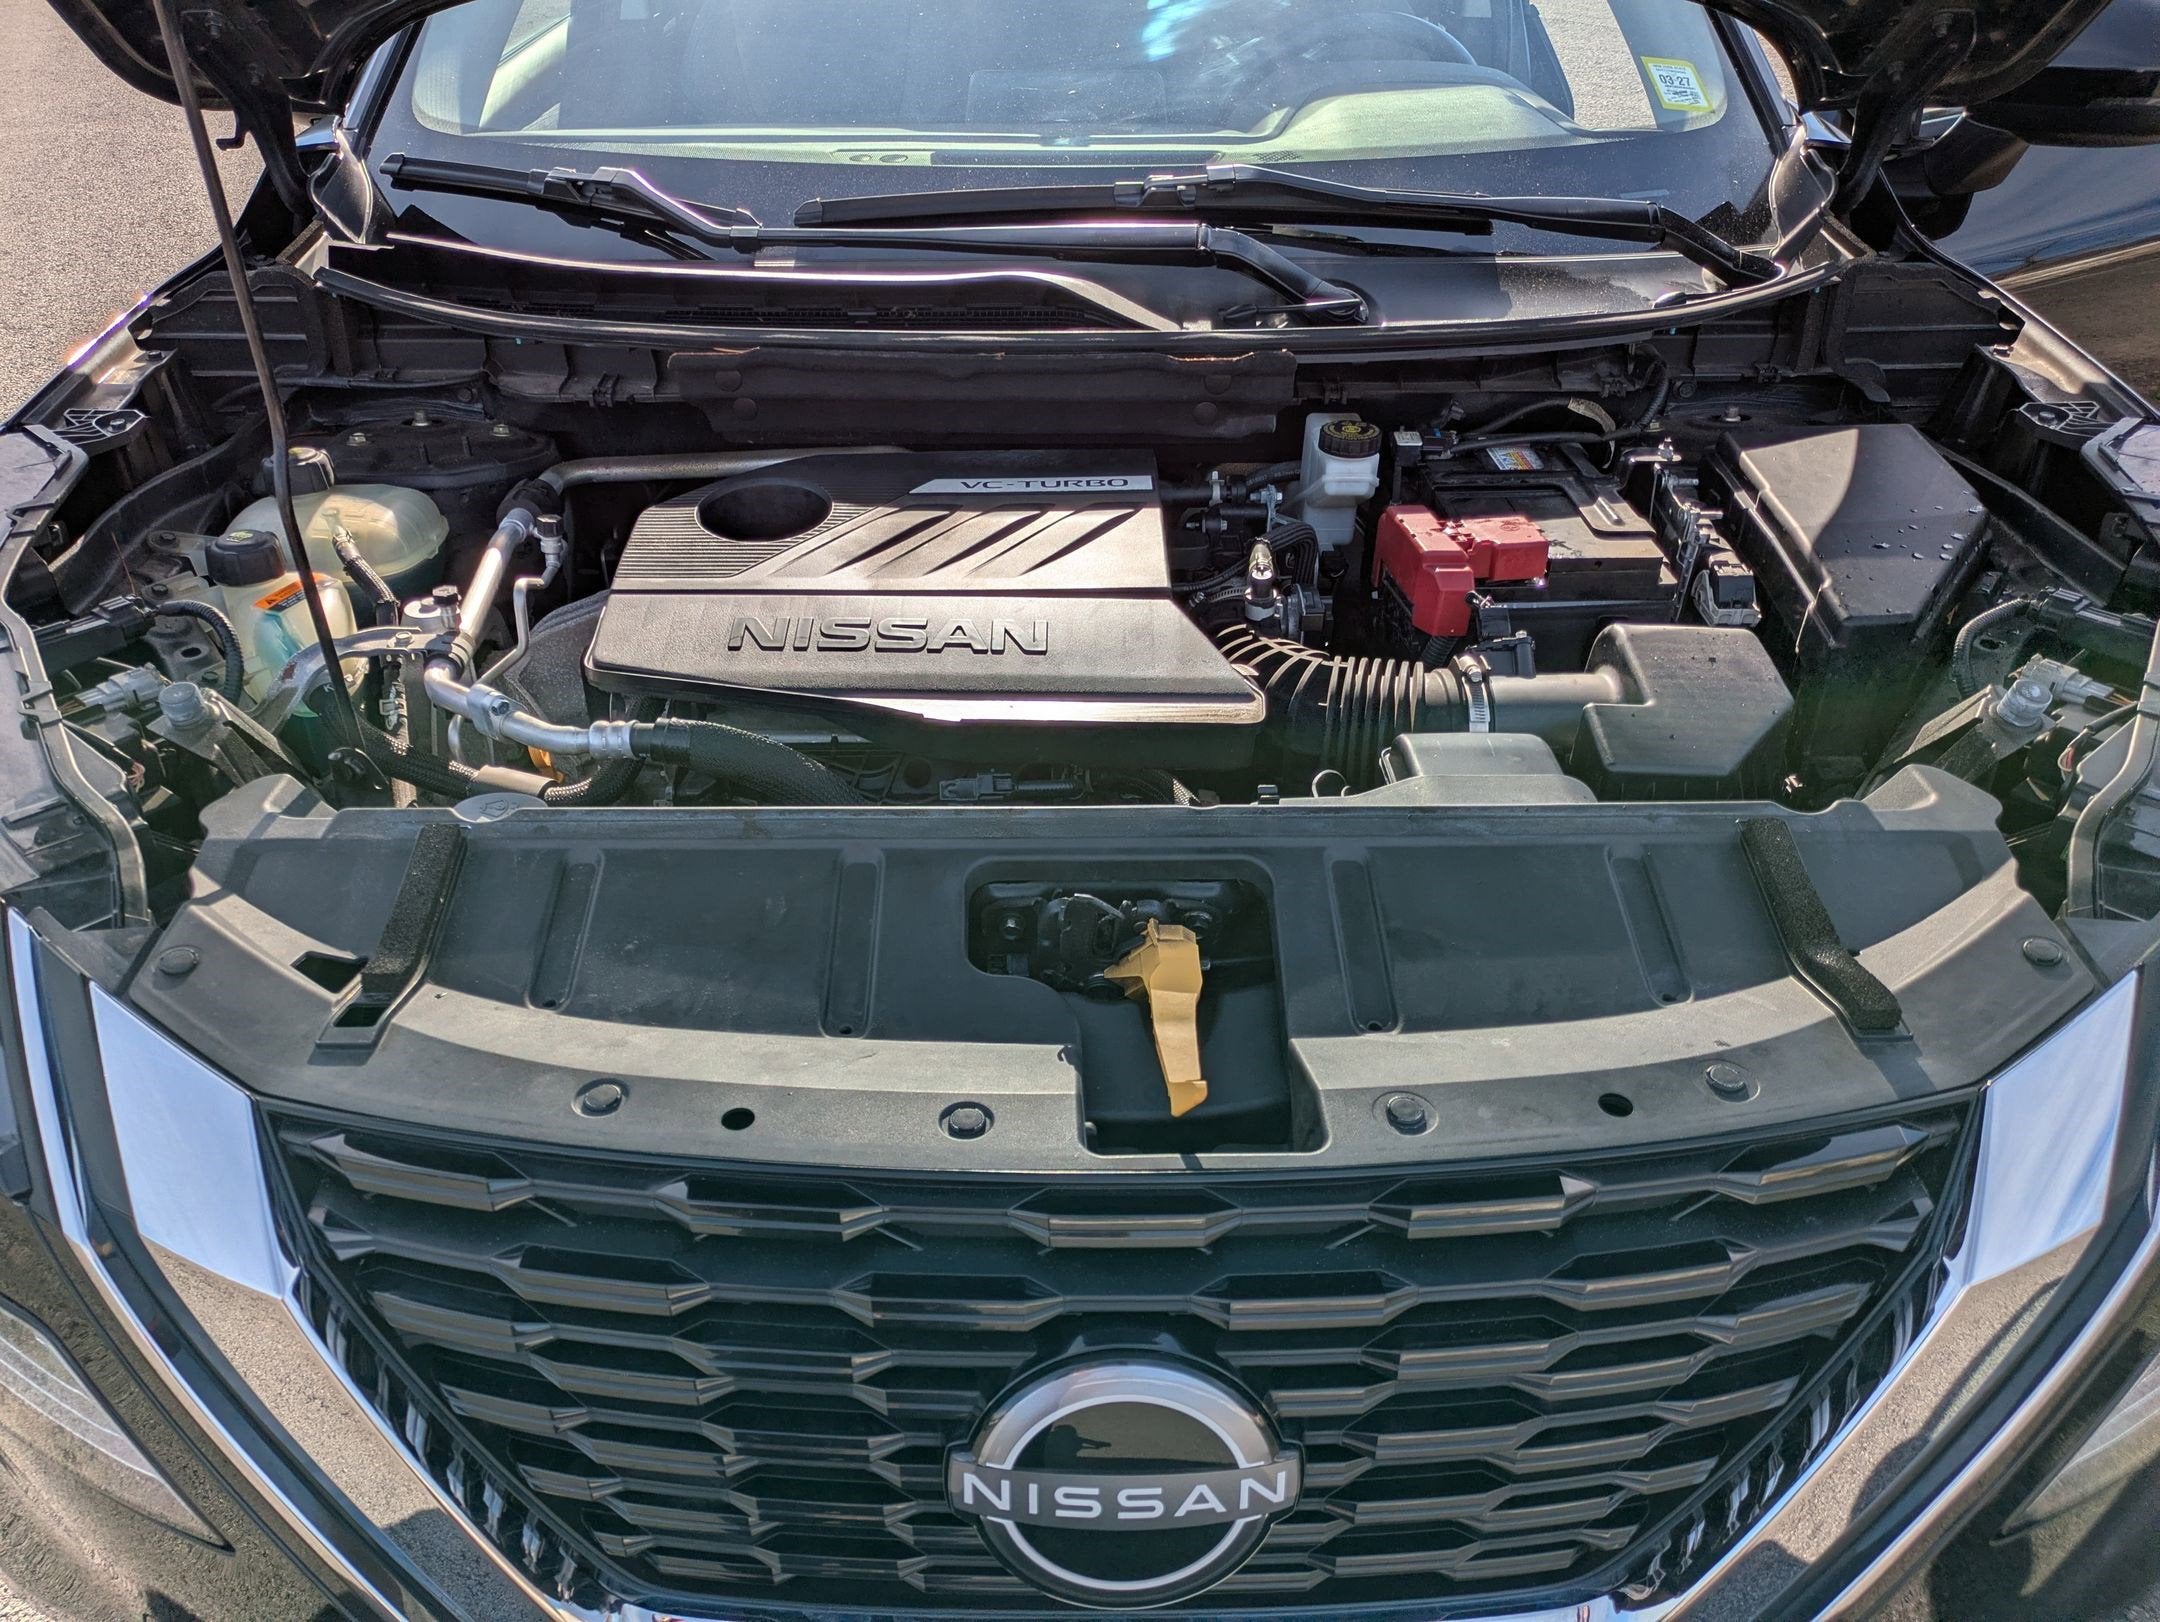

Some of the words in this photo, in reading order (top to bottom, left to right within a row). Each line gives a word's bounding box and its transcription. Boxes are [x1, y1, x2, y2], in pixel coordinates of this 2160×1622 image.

[1658, 74, 1675, 85] 03
[1676, 76, 1690, 87] 27
[960, 478, 1130, 490] VC-TURBO
[727, 615, 1049, 656] NISSAN
[962, 1470, 1288, 1520] NISSAN
